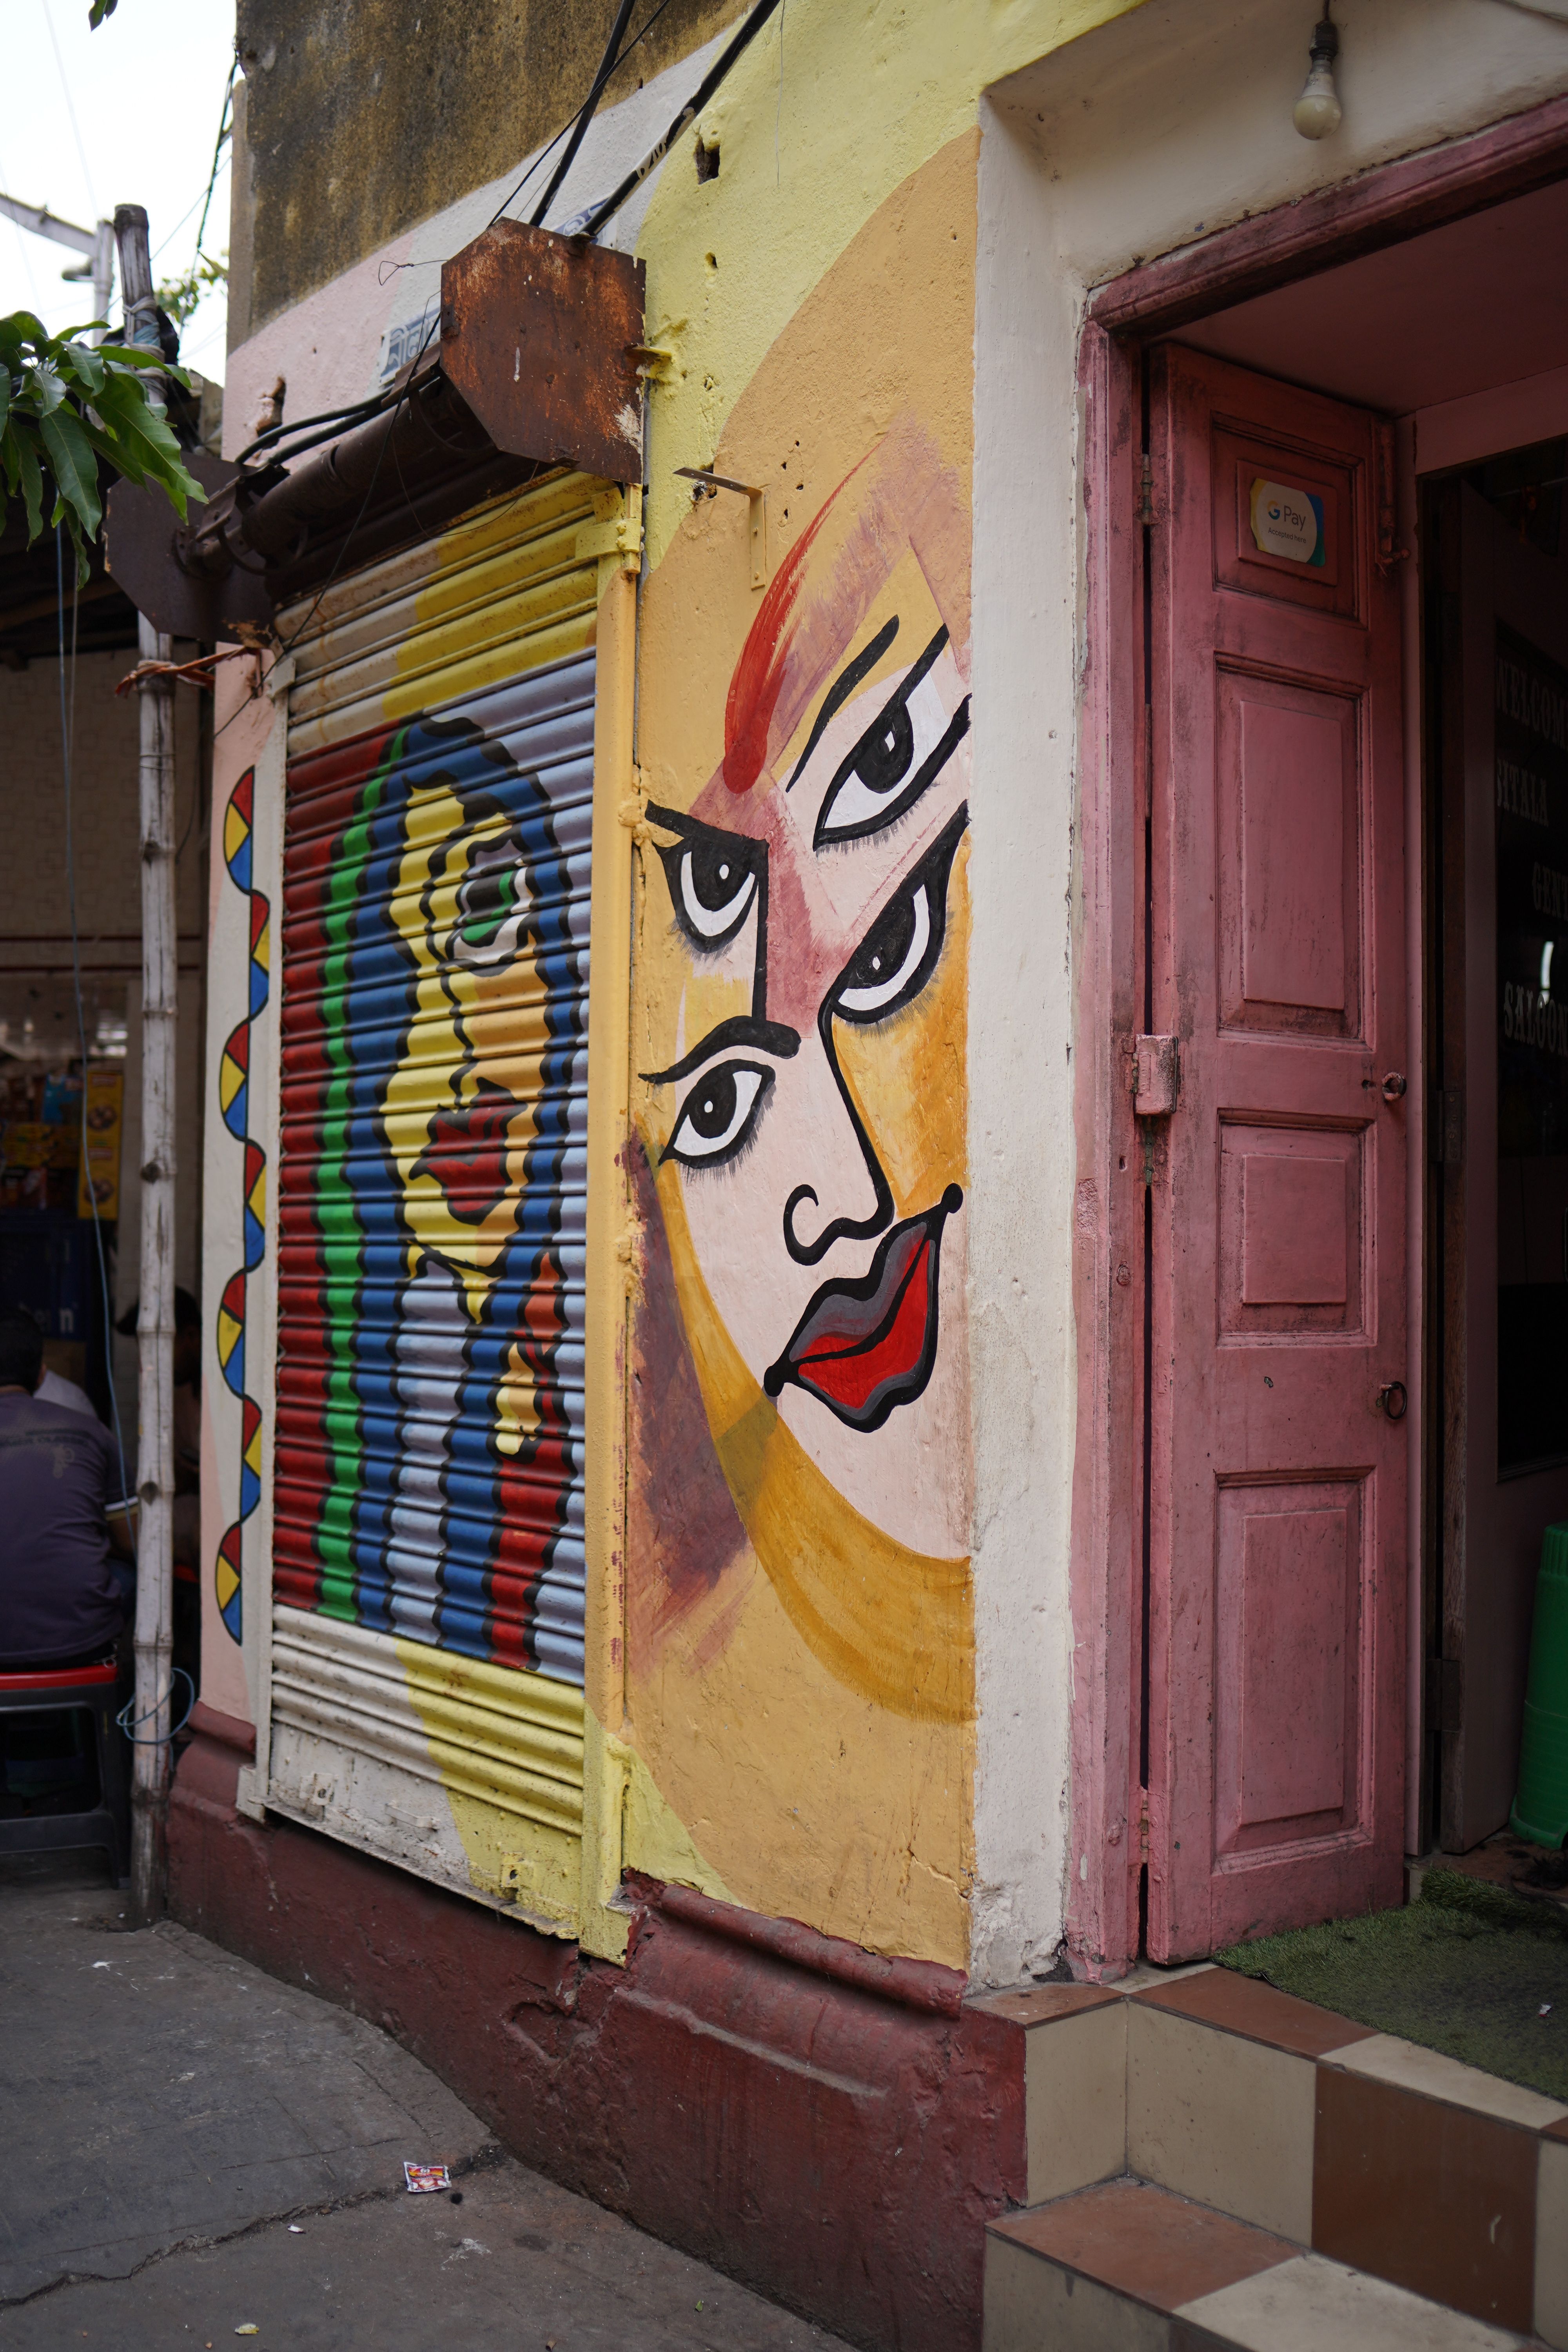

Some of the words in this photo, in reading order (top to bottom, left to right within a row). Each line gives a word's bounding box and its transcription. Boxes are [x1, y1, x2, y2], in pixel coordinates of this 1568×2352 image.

[1284, 505, 1306, 531] Pay
[1269, 527, 1293, 539] Accepted
[1294, 534, 1306, 543] here
